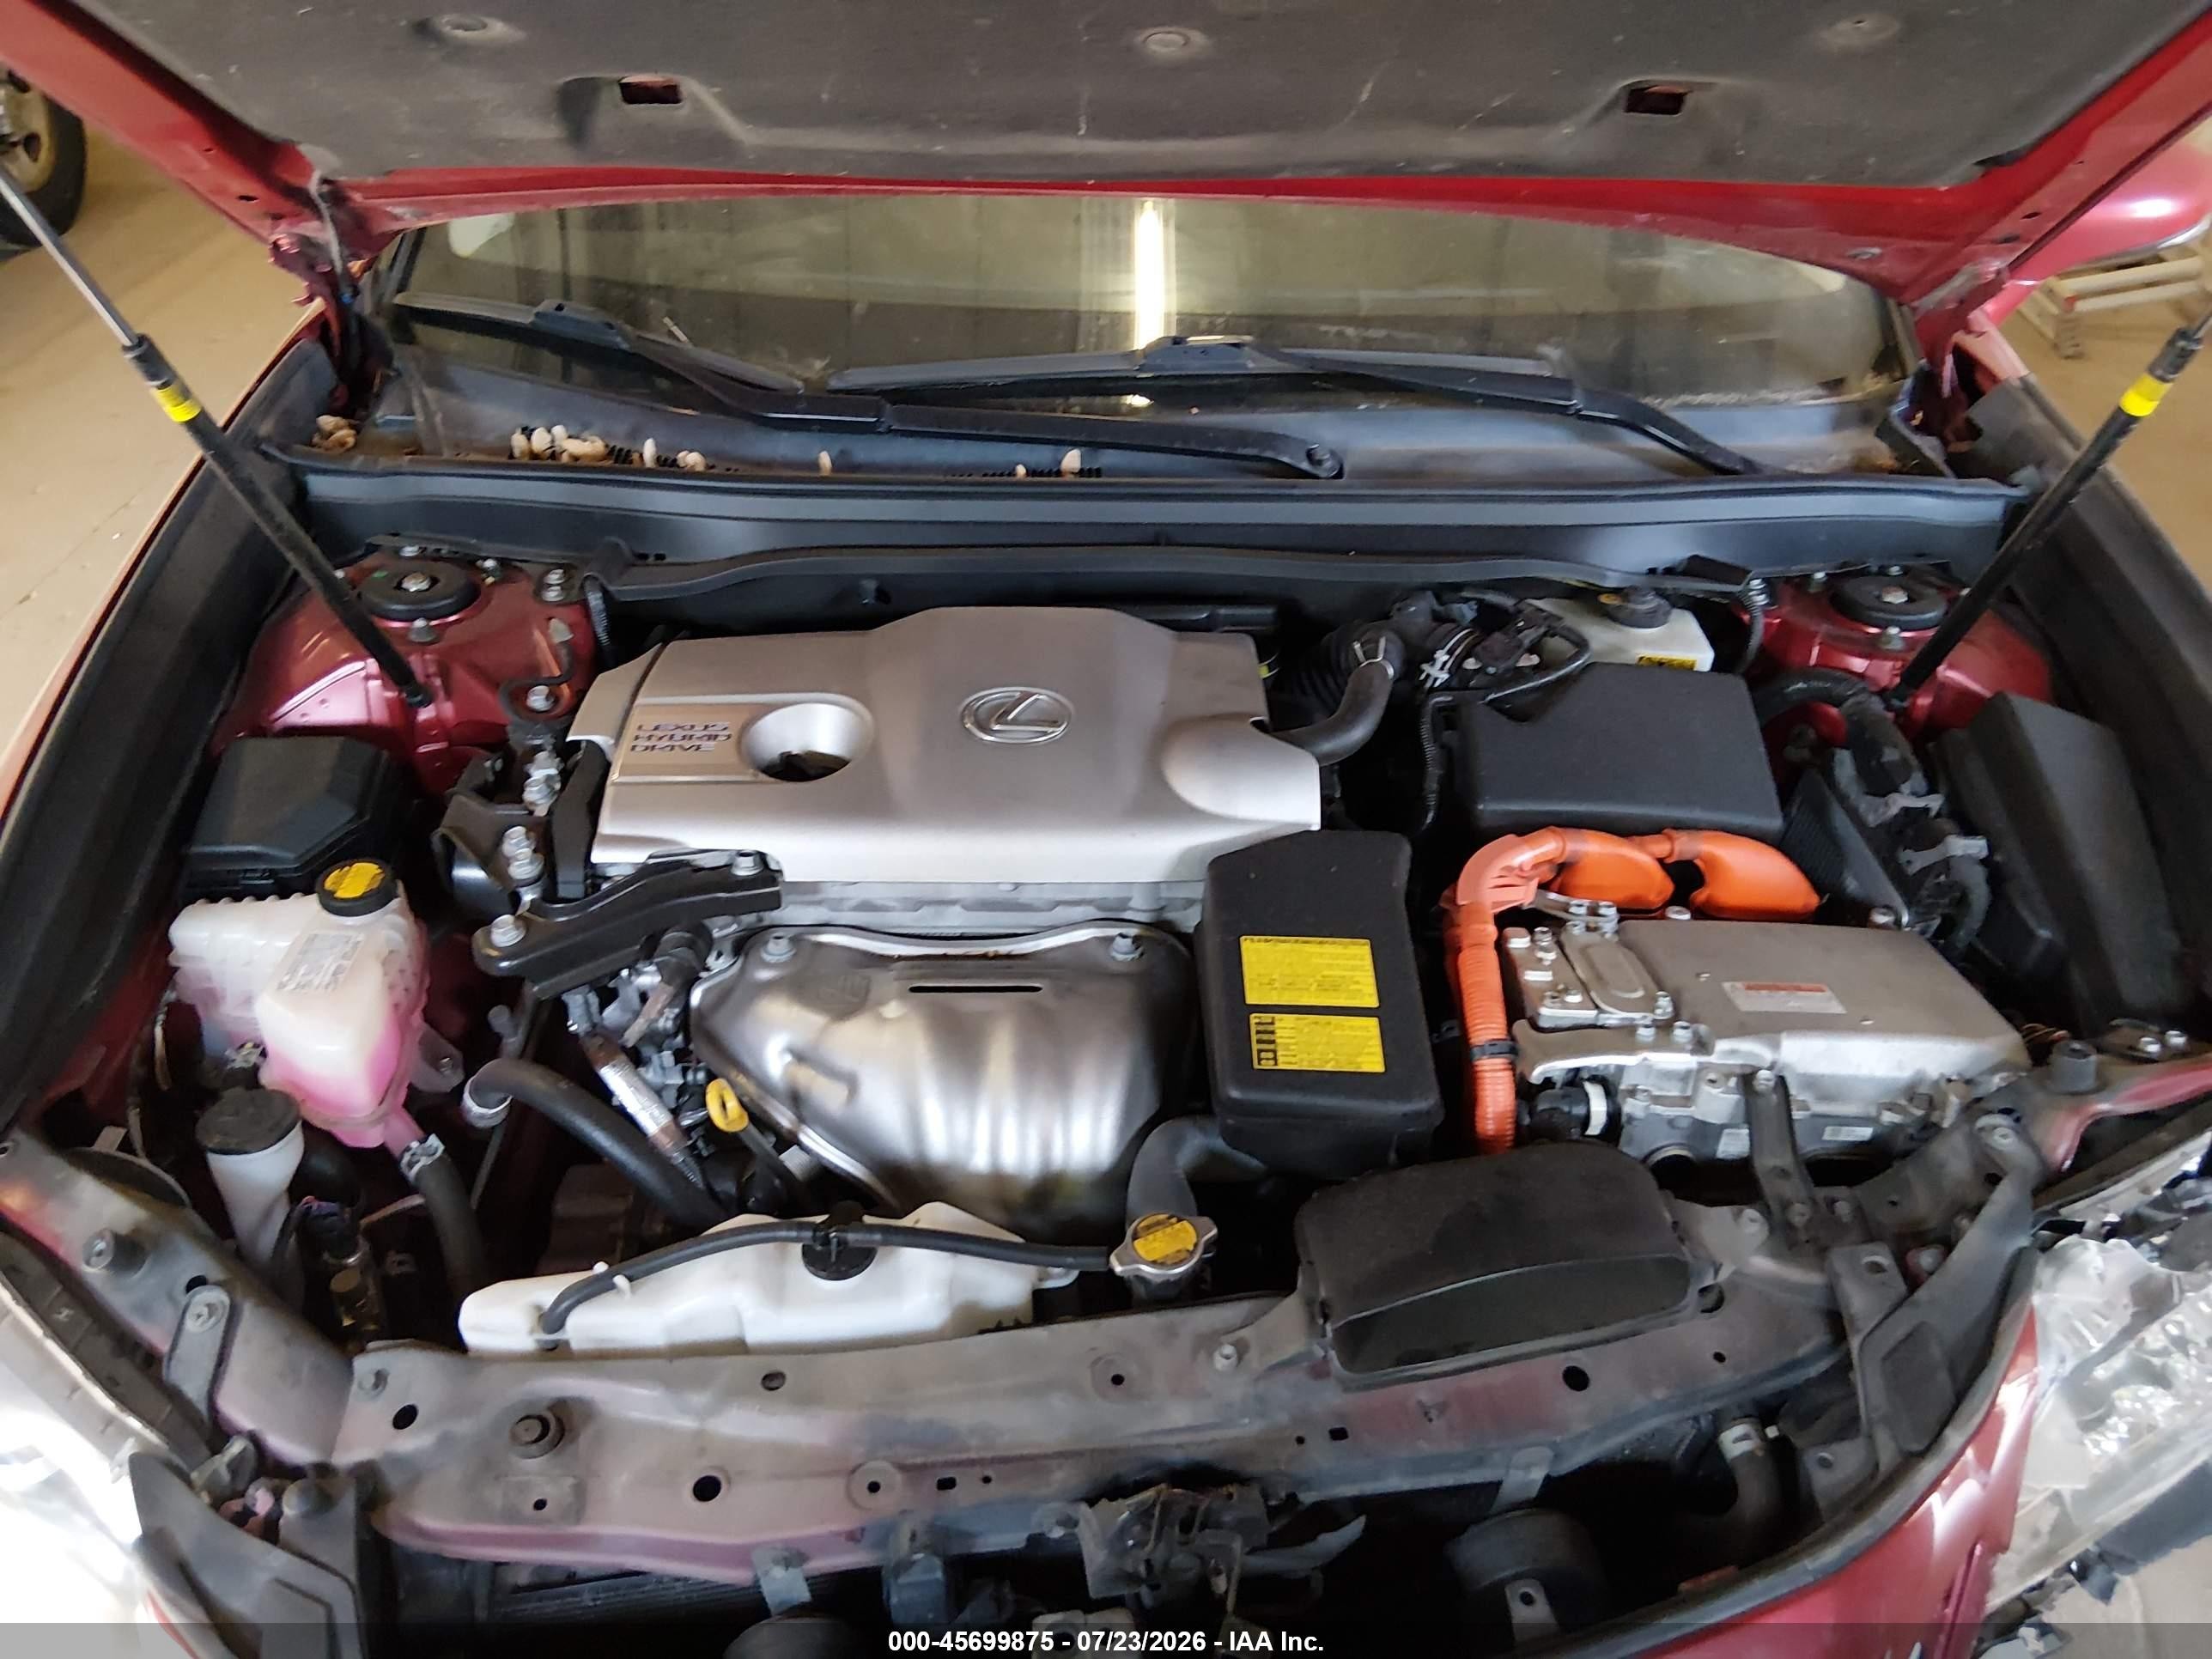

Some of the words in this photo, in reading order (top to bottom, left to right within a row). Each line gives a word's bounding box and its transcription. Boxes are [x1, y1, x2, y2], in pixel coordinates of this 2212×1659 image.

[636, 722, 729, 732] LEXUS
[633, 732, 732, 742] HYBRID
[630, 743, 714, 752] DRIVE
